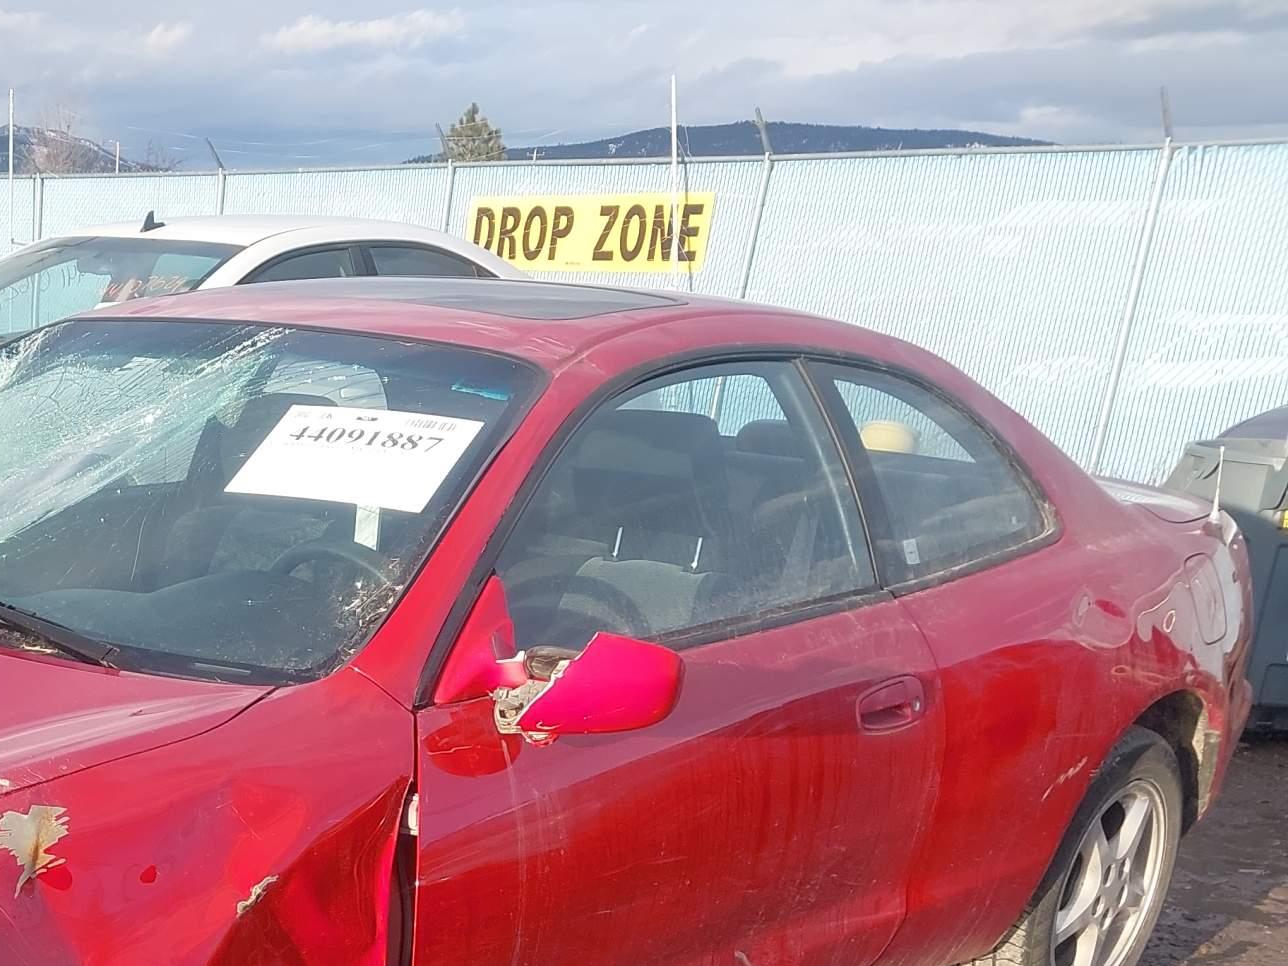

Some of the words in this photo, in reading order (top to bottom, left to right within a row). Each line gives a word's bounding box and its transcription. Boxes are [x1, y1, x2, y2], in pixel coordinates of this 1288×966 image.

[473, 205, 575, 262] DROP
[592, 203, 705, 262] ZONE
[289, 425, 445, 453] 44091887
